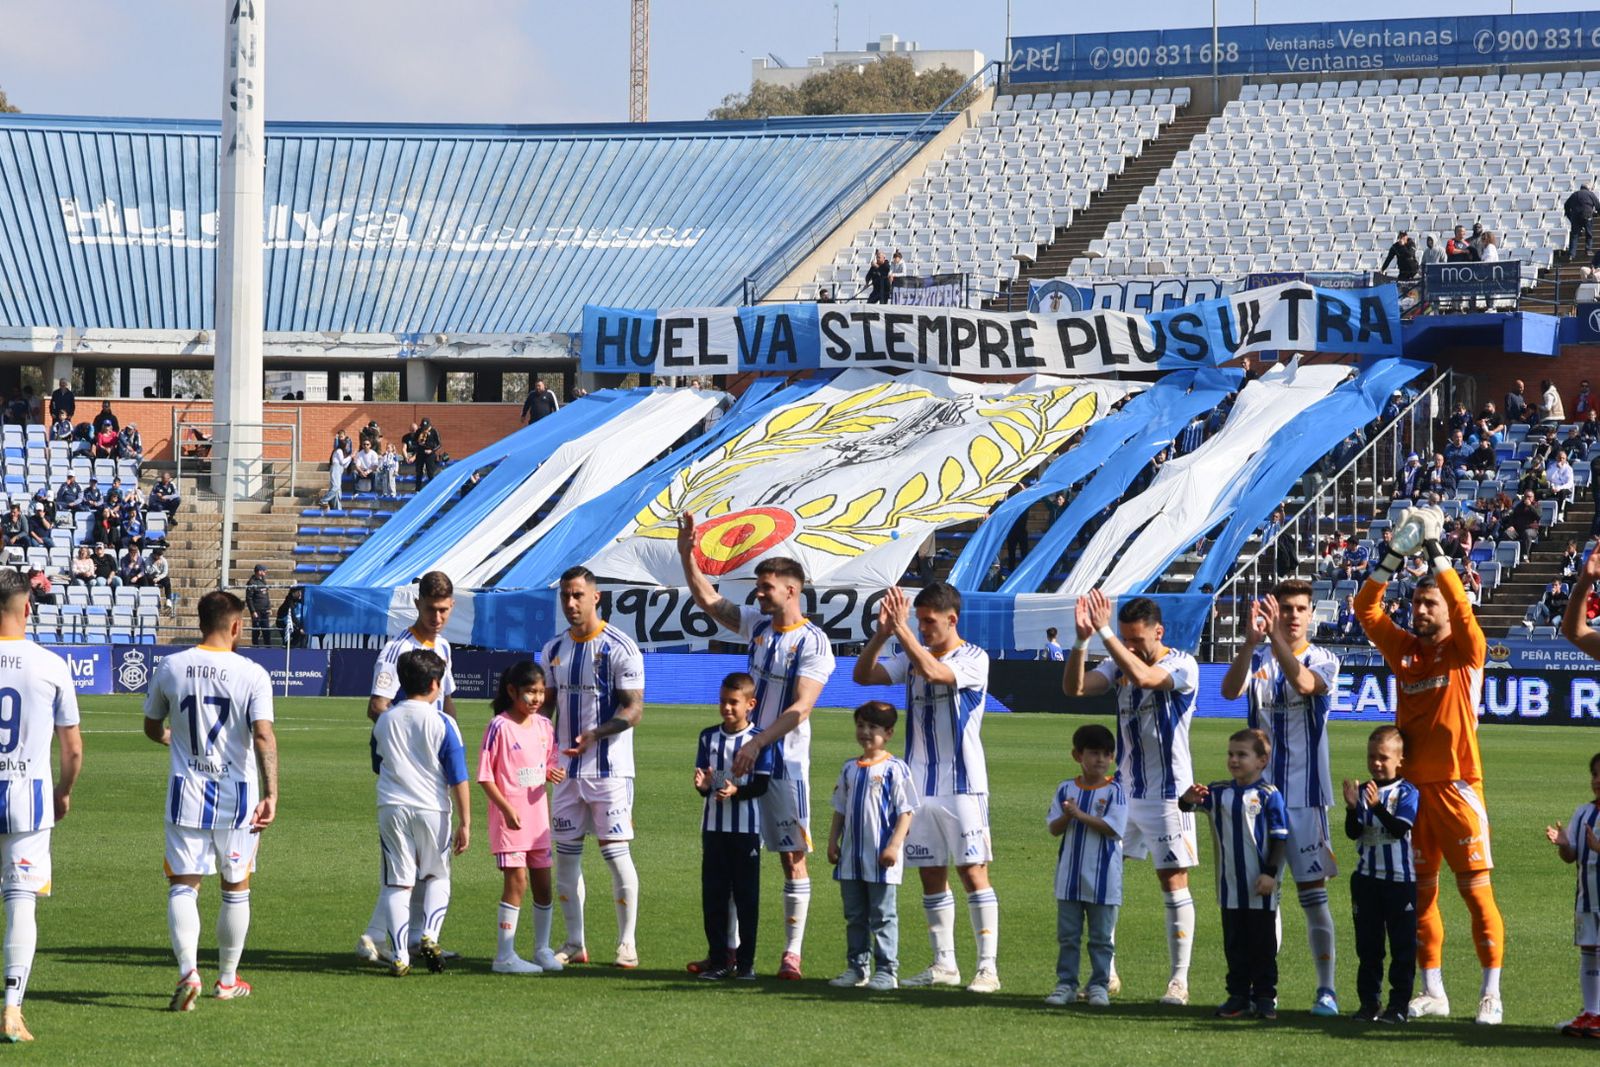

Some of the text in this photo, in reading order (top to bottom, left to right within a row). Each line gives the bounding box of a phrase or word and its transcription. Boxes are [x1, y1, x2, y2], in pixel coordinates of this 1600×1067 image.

[1265, 28, 1453, 51] Ventanas Ventanas
[1497, 29, 1539, 51] 900
[1544, 27, 1582, 49] 831
[1112, 47, 1150, 68] 900
[1155, 44, 1191, 65] 831
[1285, 52, 1439, 71] Ventanas Ventanas
[596, 288, 1393, 369] HUELVA SIEMPRE PLUS ULTRA
[1521, 650, 1551, 660] PEÑA
[186, 665, 216, 679] AITOR
[180, 694, 230, 756] 17
[188, 759, 229, 775] Huelva
[906, 844, 929, 855] Olin
